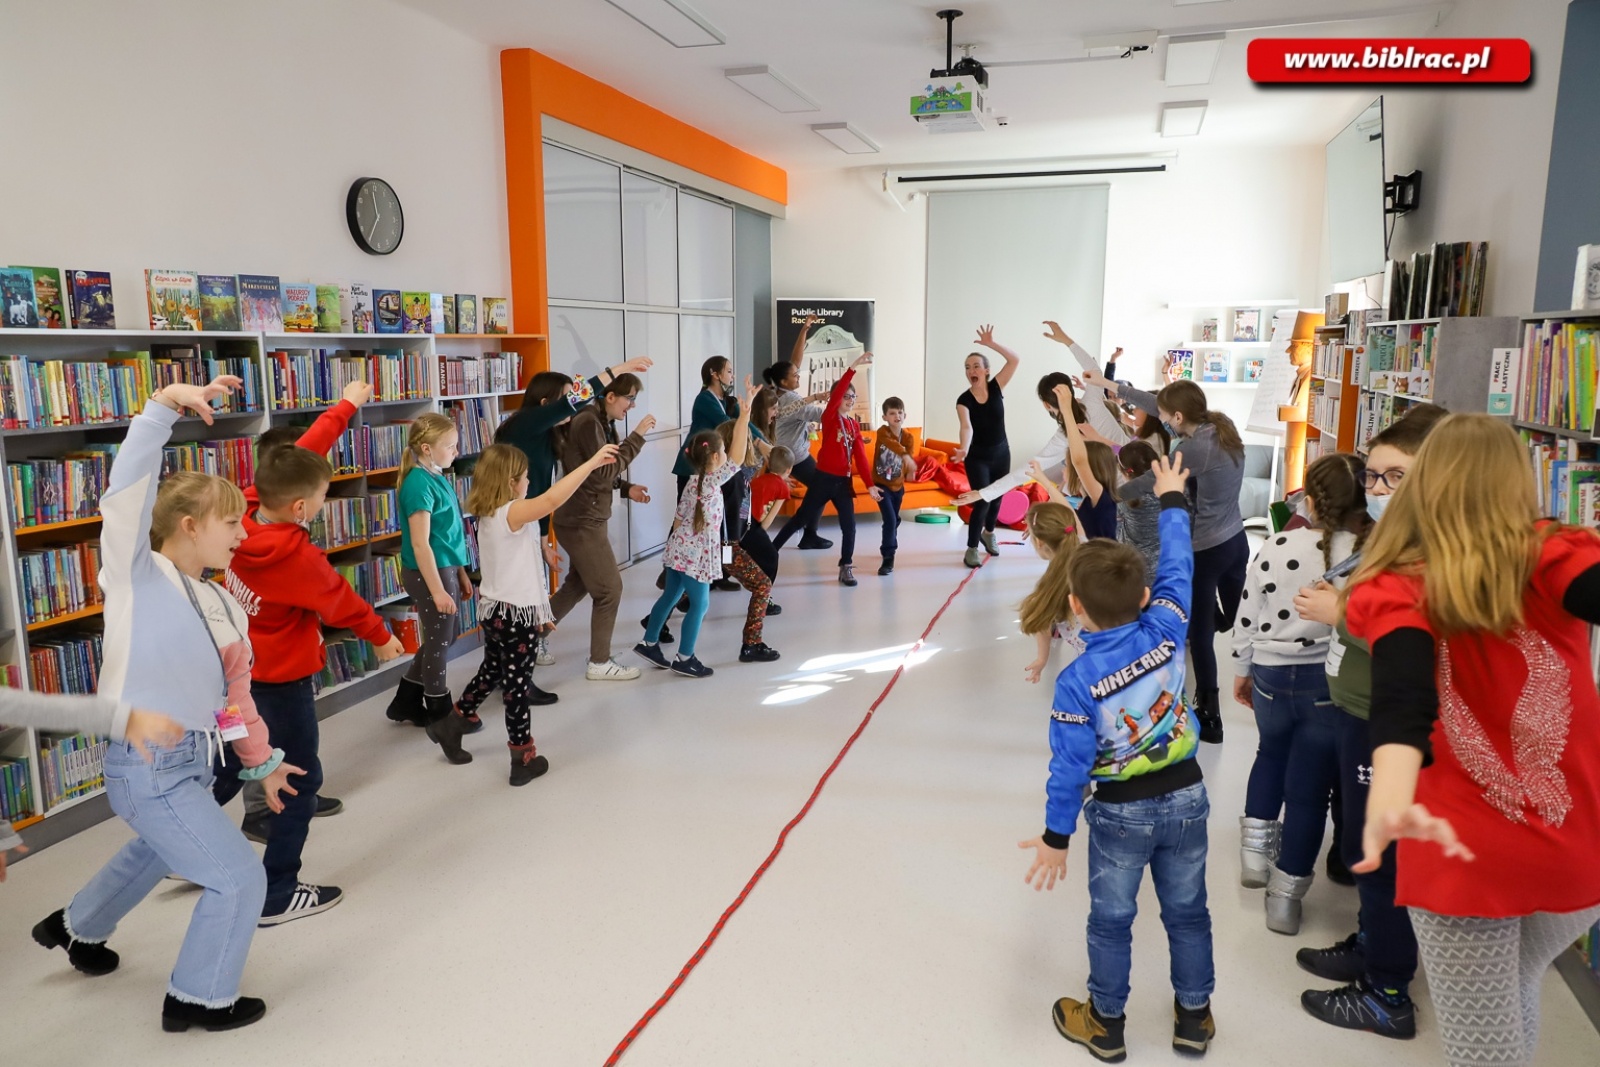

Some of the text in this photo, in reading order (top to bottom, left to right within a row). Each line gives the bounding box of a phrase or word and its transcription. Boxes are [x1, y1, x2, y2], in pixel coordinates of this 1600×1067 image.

[791, 308, 844, 318] Public Library
[439, 362, 447, 390] MANGA
[1493, 361, 1501, 383] PRACE
[1501, 350, 1511, 393] PLASTYCZNE
